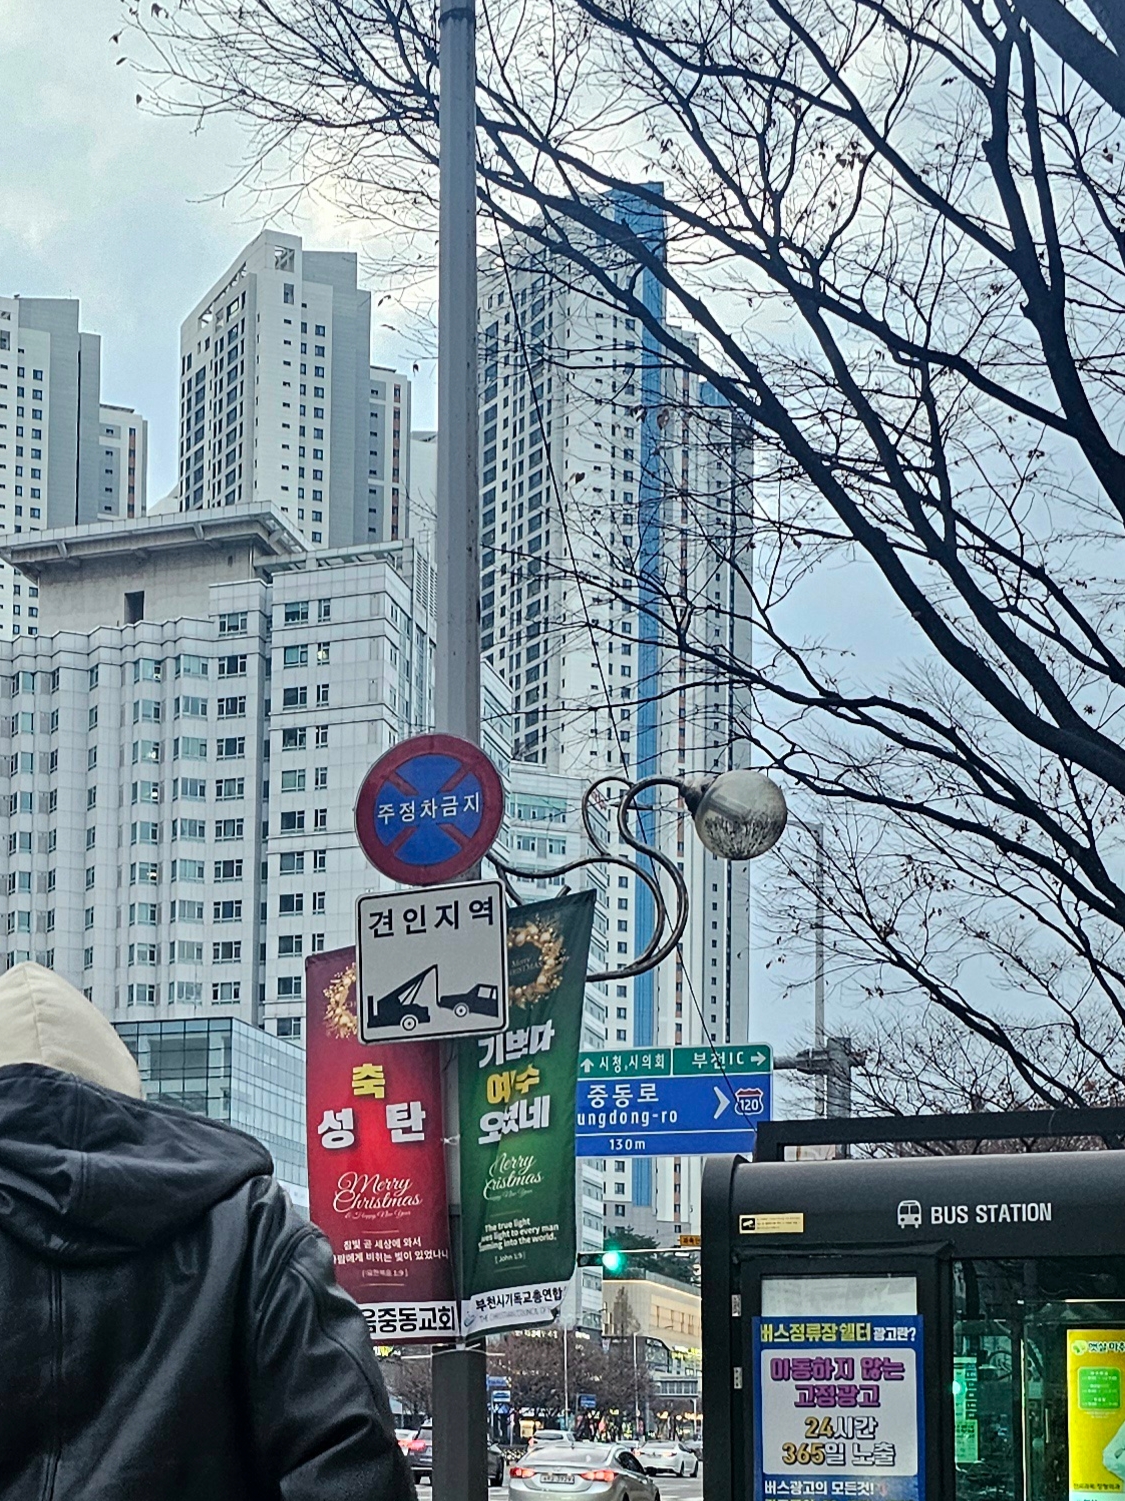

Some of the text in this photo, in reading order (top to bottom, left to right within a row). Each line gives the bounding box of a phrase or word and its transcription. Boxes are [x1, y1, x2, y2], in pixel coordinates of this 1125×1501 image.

[377, 791, 480, 825] 주정차금지
[368, 896, 494, 939] 견인지역
[599, 1053, 665, 1073] 시청,시의회
[351, 1063, 386, 1099] 축
[587, 1083, 659, 1109] 중동로
[739, 1098, 759, 1112] 120
[577, 1110, 678, 1129] ungdong-ro
[609, 1139, 646, 1151] 130m
[337, 1171, 413, 1197] Merry
[333, 1189, 423, 1213] Christmas
[485, 1217, 531, 1233] The true light
[931, 1202, 1052, 1225] BUS STATION
[375, 1237, 401, 1250] 세상에
[403, 1236, 422, 1248] 와서
[493, 1229, 511, 1242] light
[511, 1228, 519, 1237] to
[519, 1226, 541, 1236] every
[541, 1224, 559, 1232] man
[504, 1237, 518, 1248] into
[518, 1235, 531, 1245] the
[532, 1232, 557, 1243] world.
[394, 1250, 413, 1262] 빛이
[414, 1249, 448, 1261] 있었나니
[476, 1286, 567, 1311] 부천시기독교총연합
[760, 1322, 917, 1342] 버스정류장 쉘터 광고란?
[770, 1356, 855, 1381] 이동하지
[860, 1357, 906, 1381] 않는
[794, 1384, 881, 1408] 고정광고
[805, 1416, 878, 1440] 24시간
[782, 1441, 896, 1467] 365일 노출
[764, 1480, 875, 1496] 버스광고의 모든것!
